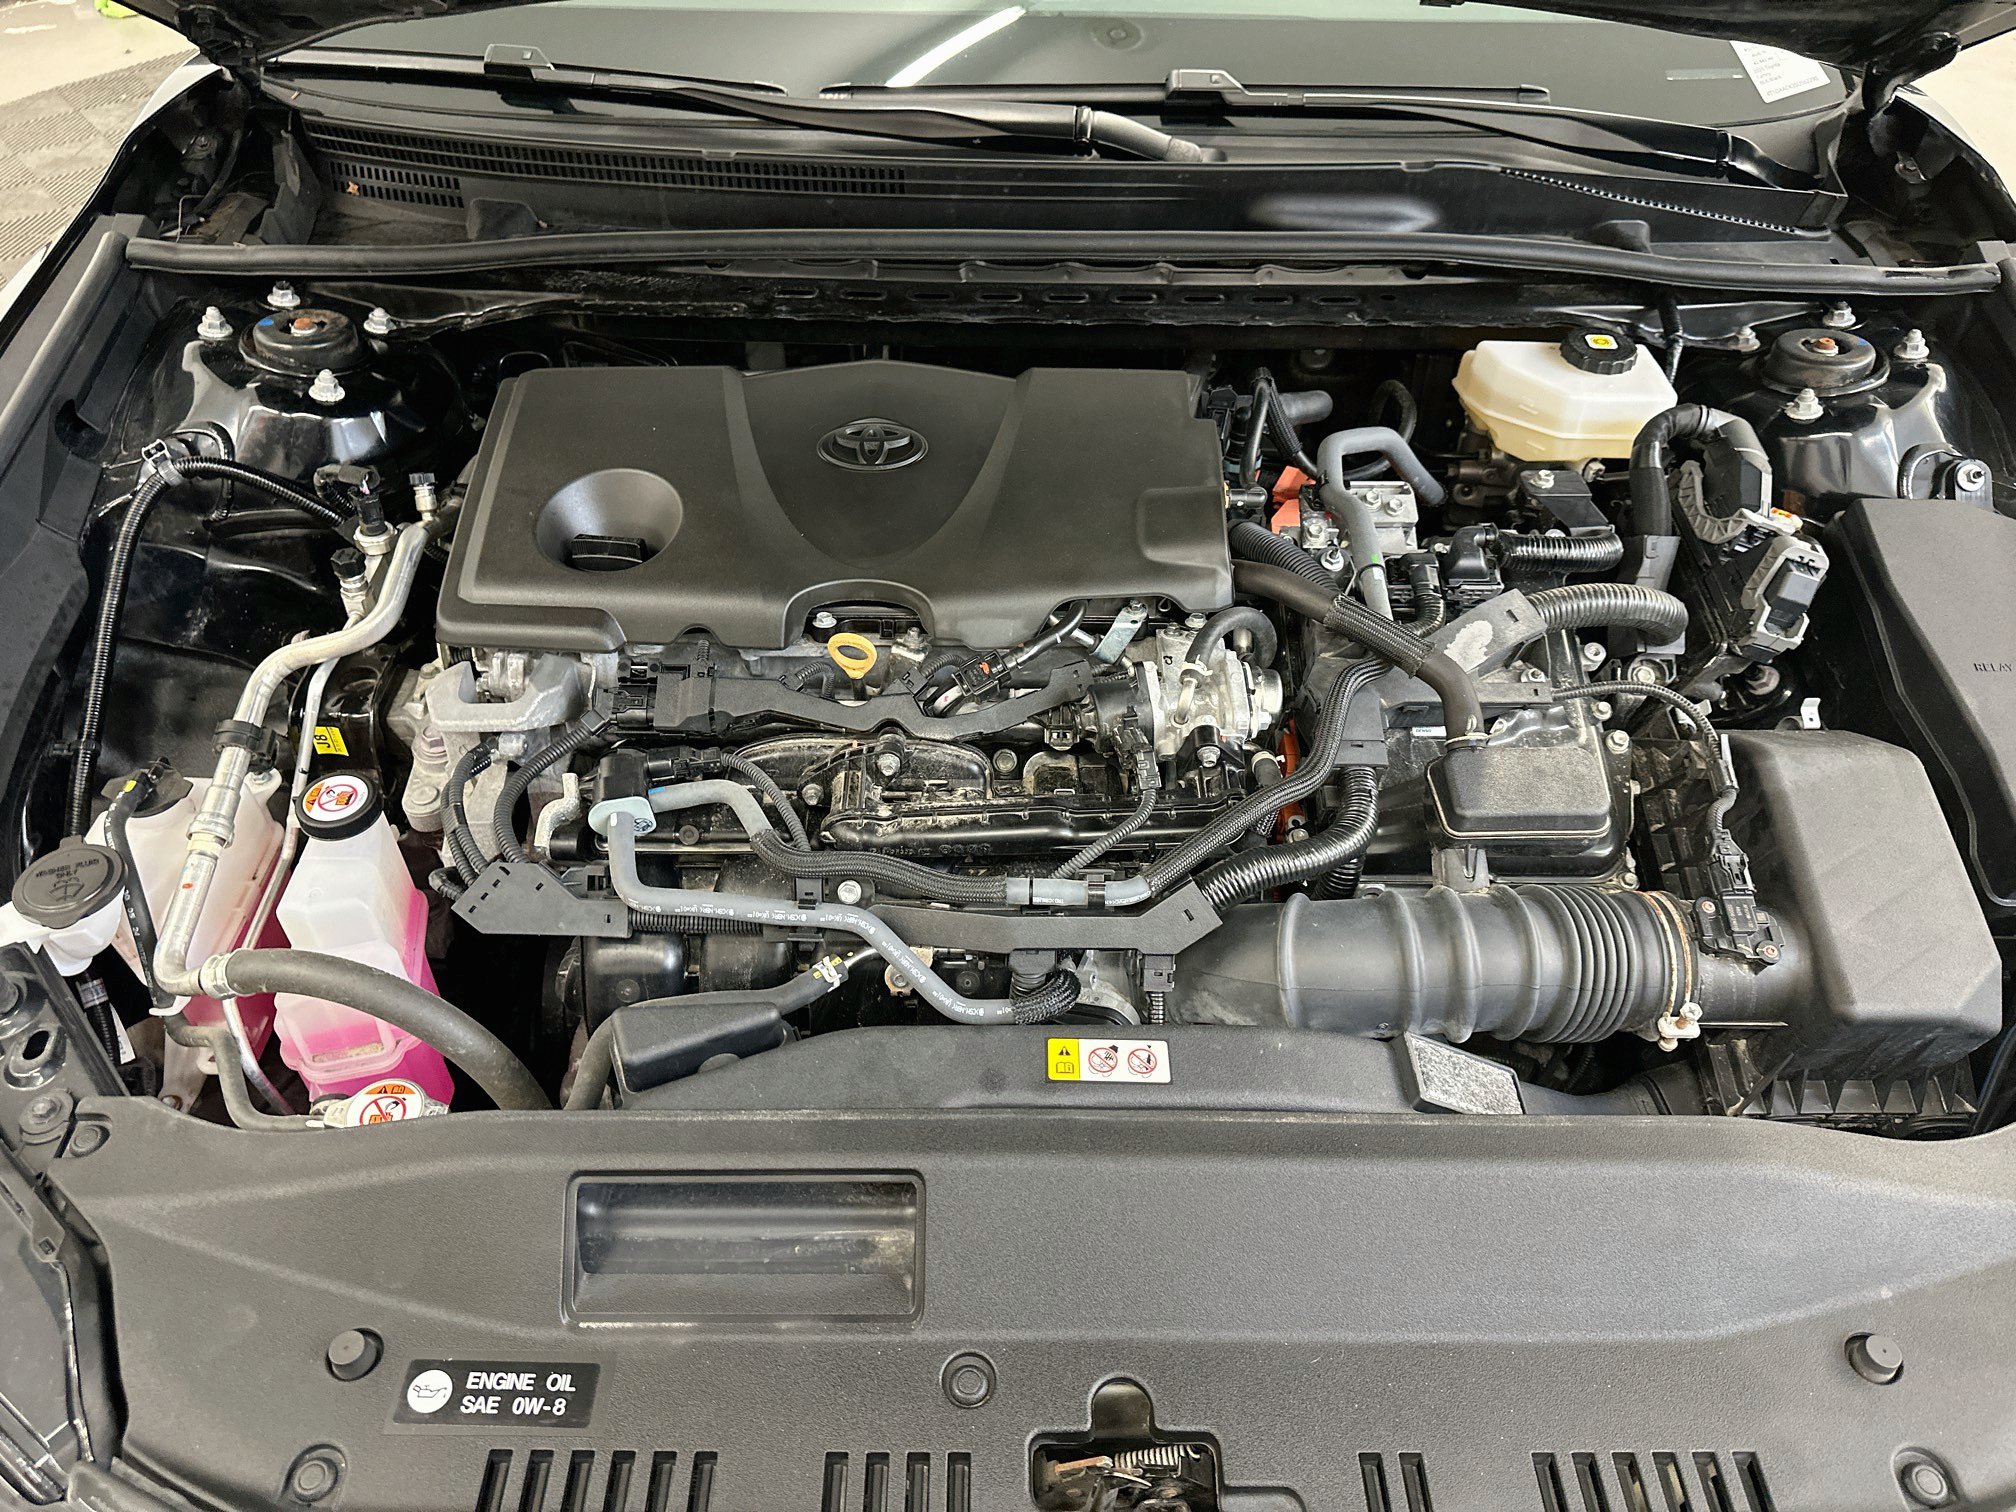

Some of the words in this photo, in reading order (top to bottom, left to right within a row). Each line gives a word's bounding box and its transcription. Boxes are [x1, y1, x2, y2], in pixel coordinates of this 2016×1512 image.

[1973, 662, 2012, 672] RELAY
[314, 734, 331, 749] J8
[465, 1372, 536, 1391] ENGINE
[546, 1373, 576, 1392] OIL
[460, 1395, 501, 1415] SAE
[511, 1396, 567, 1416] 0W-8
